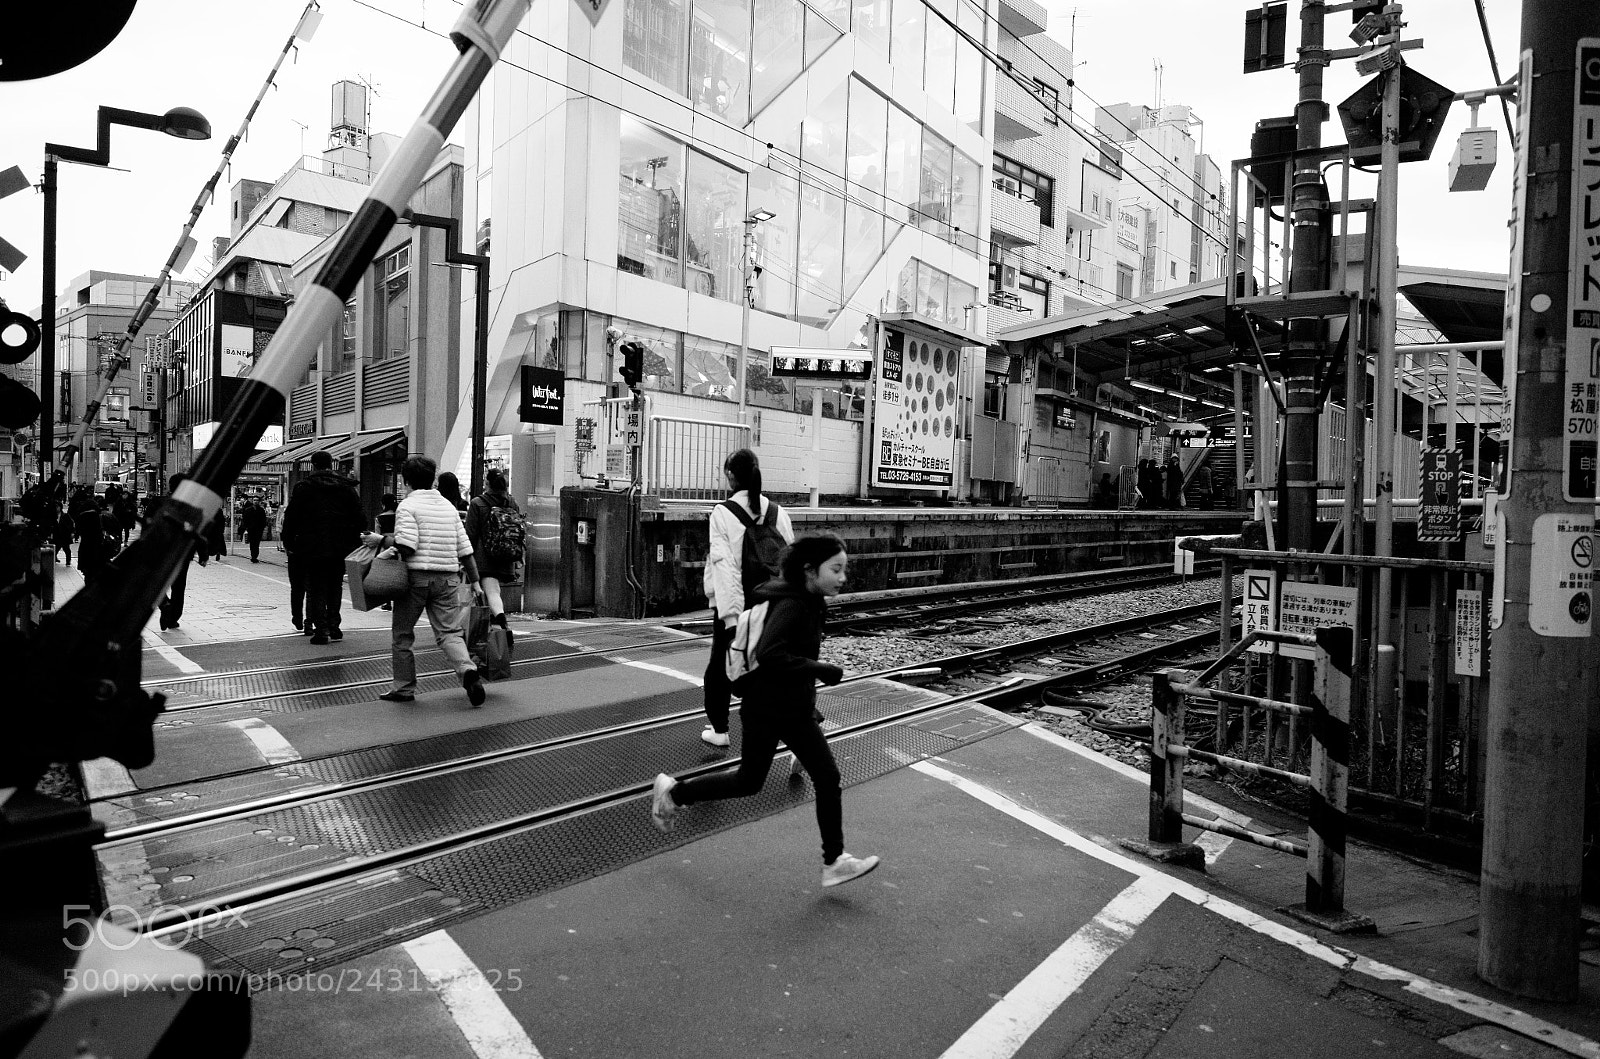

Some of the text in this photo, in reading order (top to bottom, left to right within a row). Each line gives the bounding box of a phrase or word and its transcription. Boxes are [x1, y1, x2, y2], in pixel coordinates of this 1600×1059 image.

[626, 413, 639, 444] 場内
[1428, 471, 1454, 481] STOP
[1423, 505, 1457, 515] 非常停止
[1427, 515, 1452, 524] ボタン
[1282, 593, 1353, 609] 踏切には、列車の車輪が
